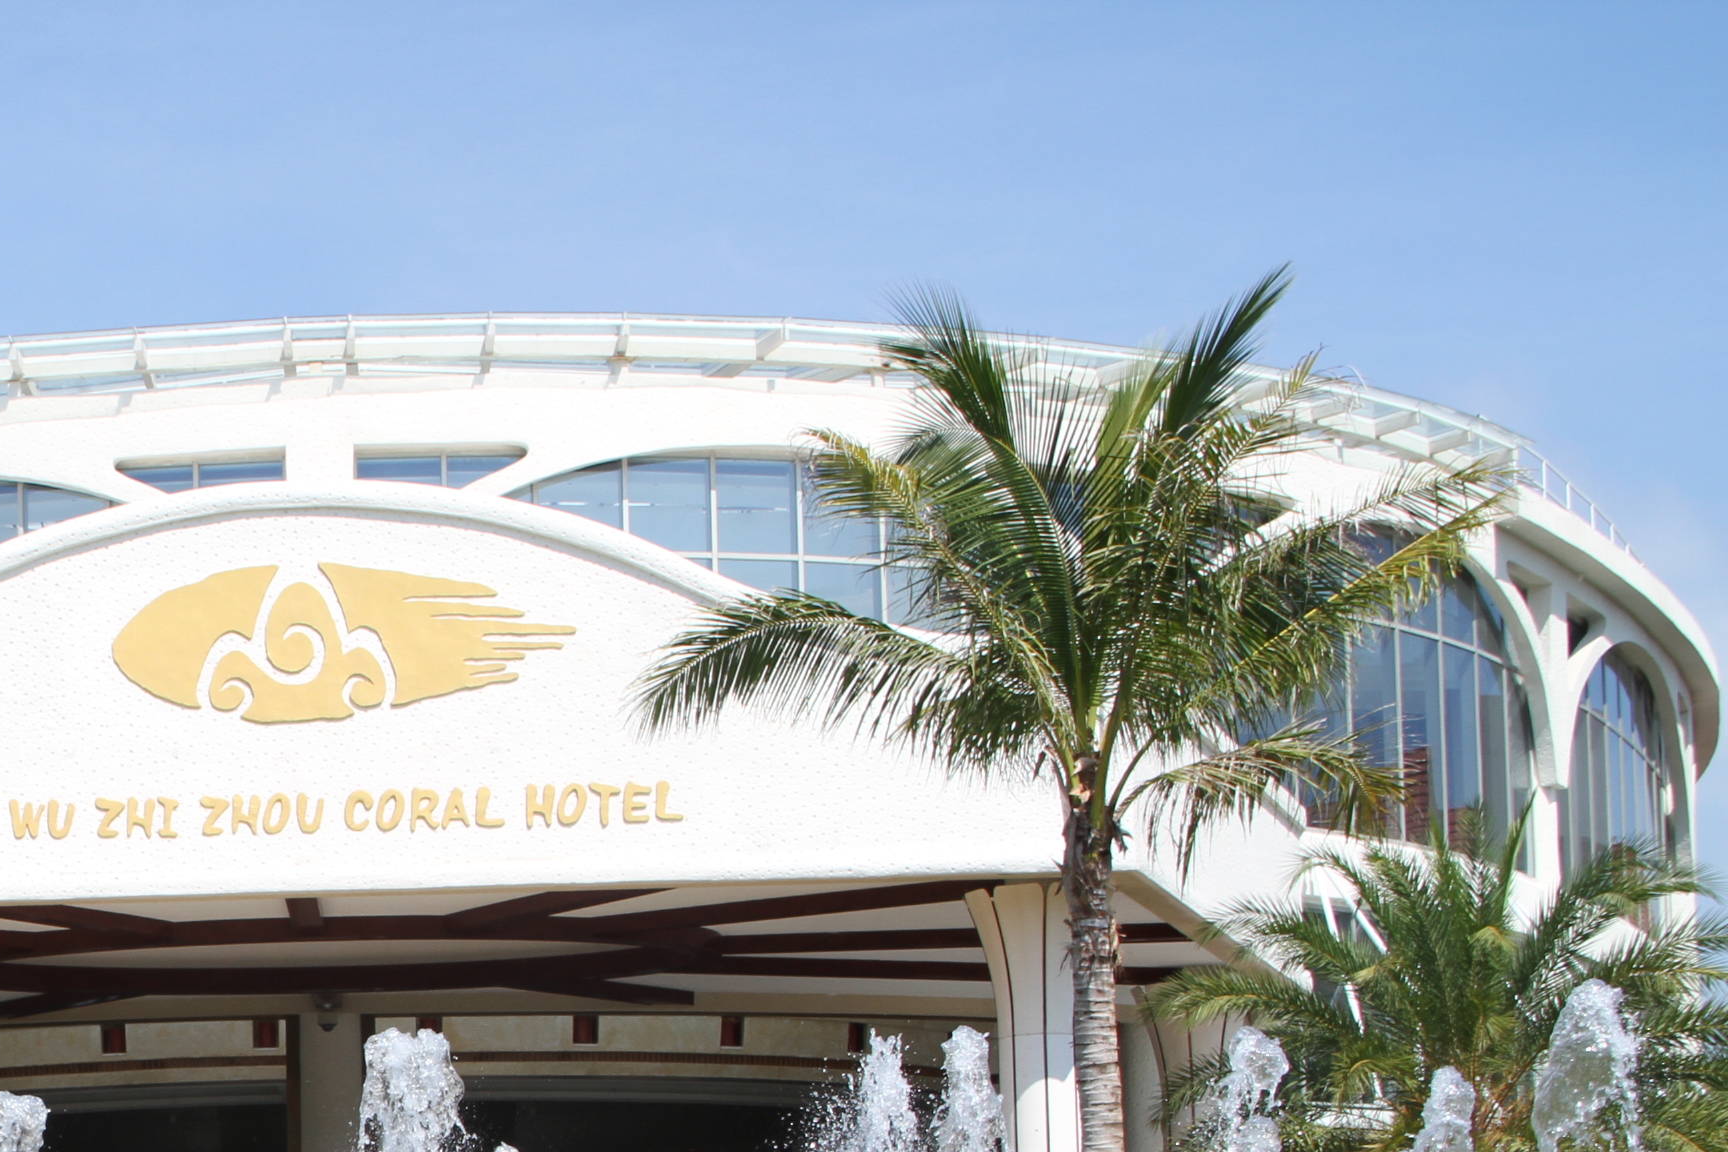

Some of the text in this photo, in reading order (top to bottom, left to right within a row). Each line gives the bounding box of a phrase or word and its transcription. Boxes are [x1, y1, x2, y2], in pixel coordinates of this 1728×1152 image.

[8, 780, 685, 840] WU ZHI ZHOU CORAL HOTEL
